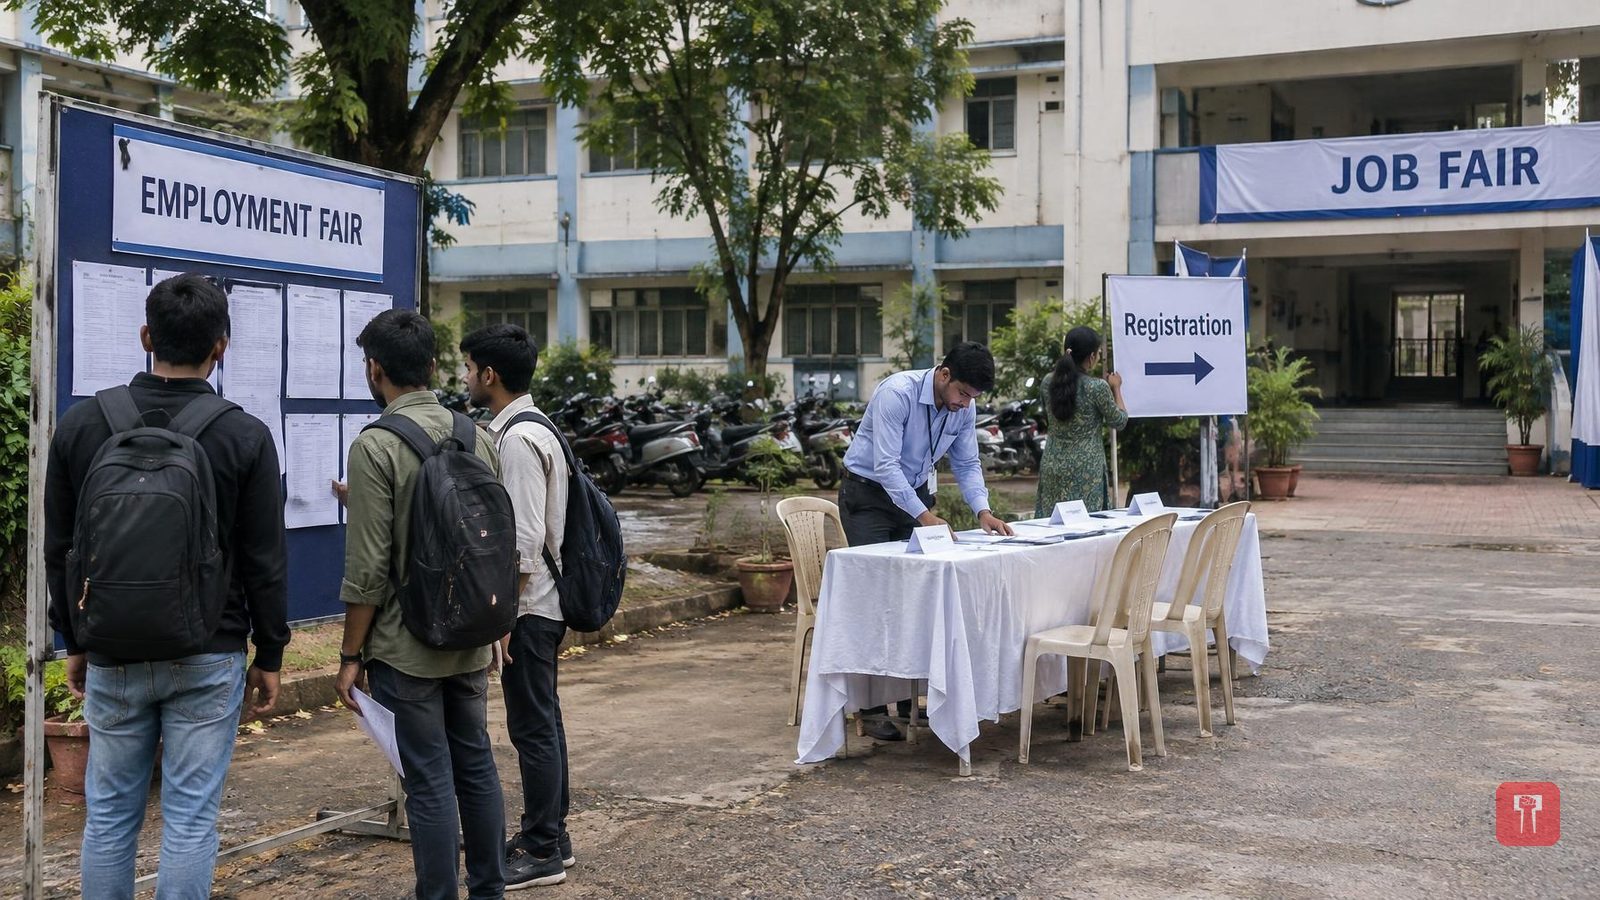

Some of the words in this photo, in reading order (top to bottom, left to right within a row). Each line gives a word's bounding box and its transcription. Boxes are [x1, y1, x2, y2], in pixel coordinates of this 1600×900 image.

[1331, 153, 1419, 195] JOB
[1439, 146, 1541, 190] FAIR
[141, 175, 313, 238] EMPLOYMENT
[319, 207, 363, 246] FAIR
[1124, 312, 1232, 343] Registration
